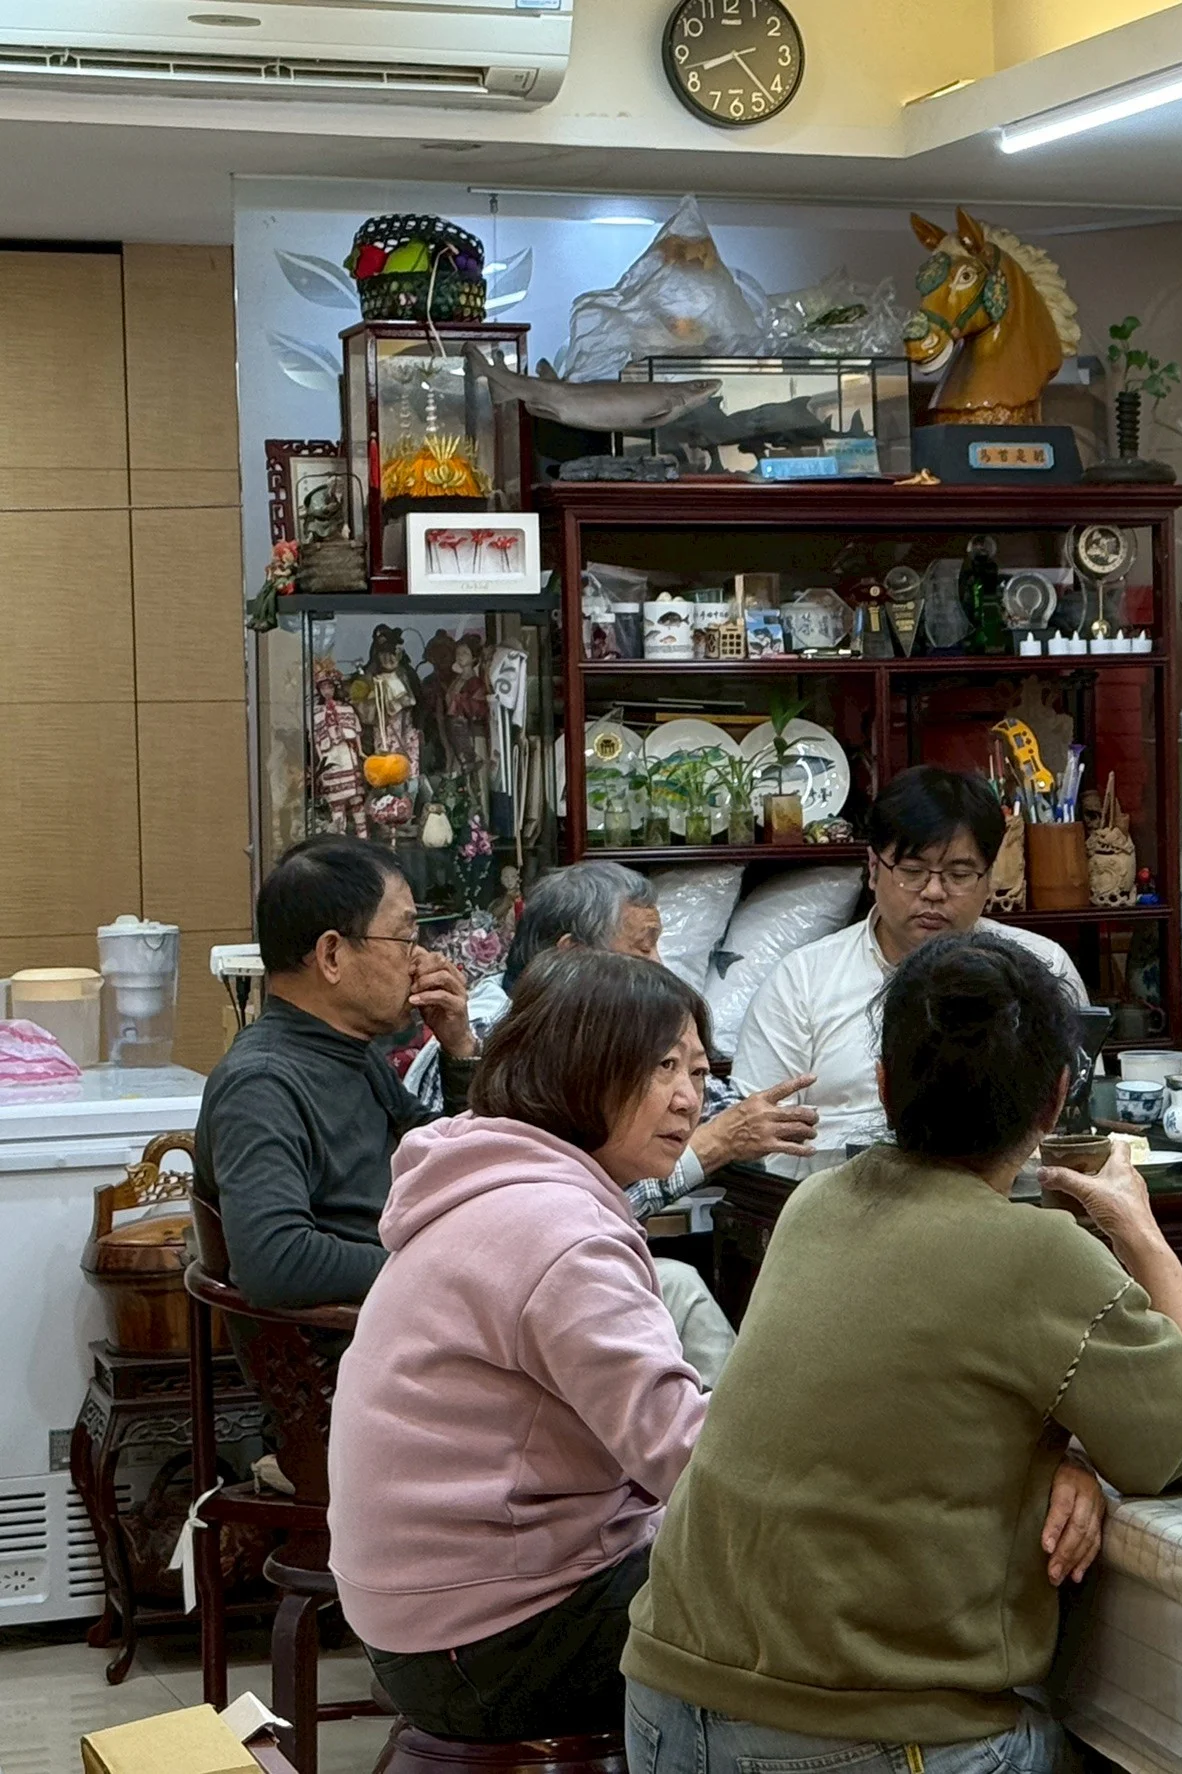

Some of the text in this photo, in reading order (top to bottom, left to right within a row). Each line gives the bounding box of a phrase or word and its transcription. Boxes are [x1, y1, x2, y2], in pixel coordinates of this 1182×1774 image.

[683, 17, 704, 38] 10
[767, 16, 781, 37] 2
[674, 44, 690, 65] 9
[778, 44, 791, 66] 3
[687, 71, 701, 92] 8
[770, 74, 783, 94] 4
[709, 91, 722, 111] 7
[730, 96, 744, 117] 6
[751, 92, 766, 112] 5
